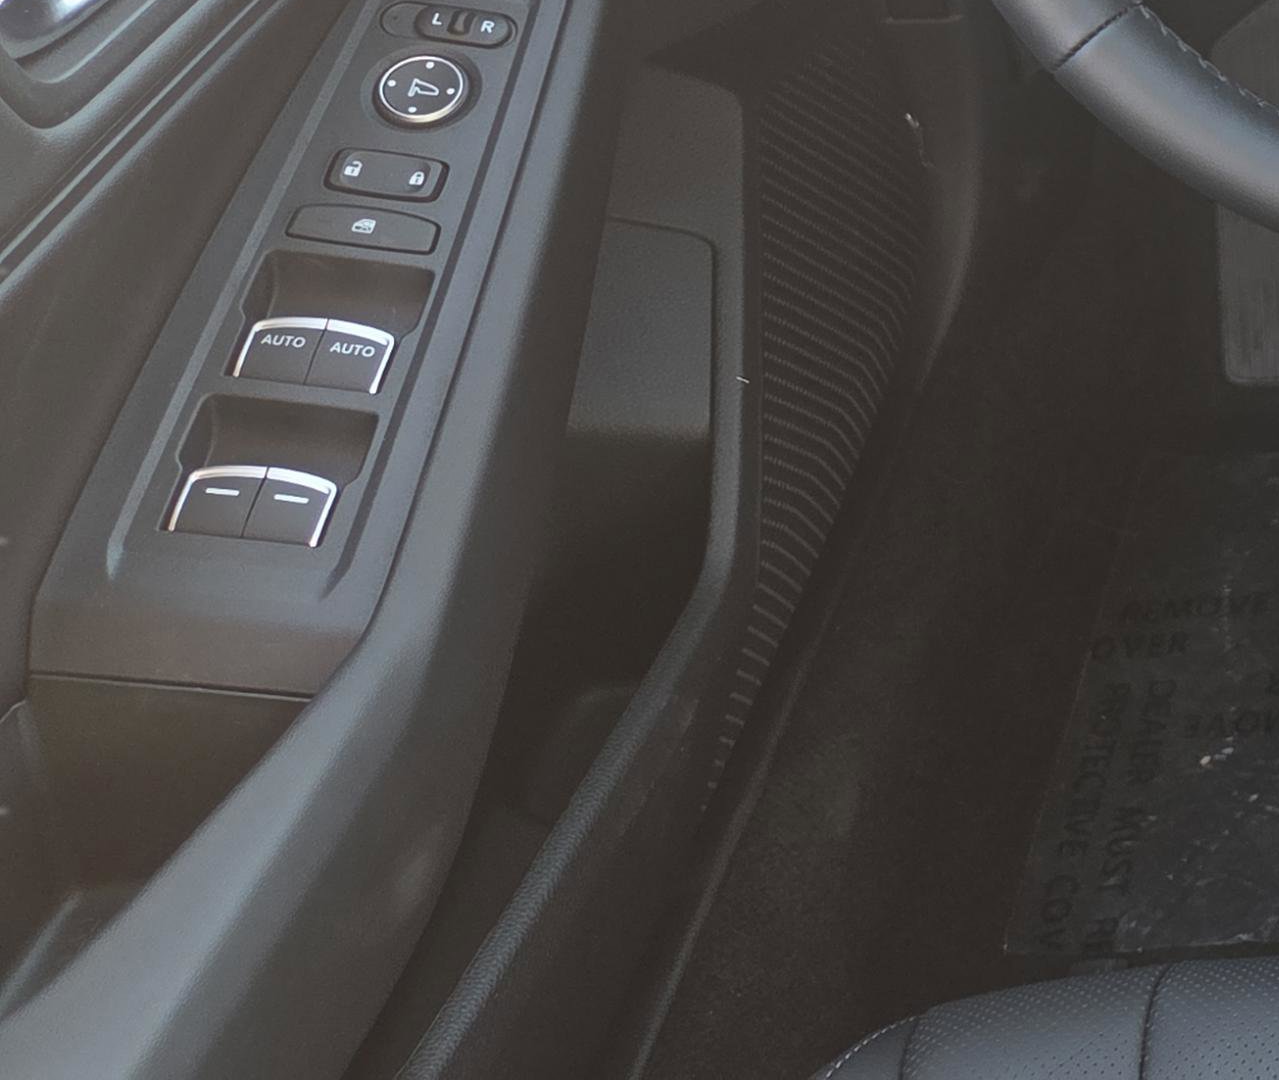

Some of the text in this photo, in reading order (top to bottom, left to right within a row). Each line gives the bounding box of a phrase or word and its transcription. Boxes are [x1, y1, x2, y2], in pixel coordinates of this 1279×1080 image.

[432, 12, 442, 26] L
[480, 19, 495, 34] R
[261, 333, 306, 350] AUTO
[329, 341, 376, 358] AUTO
